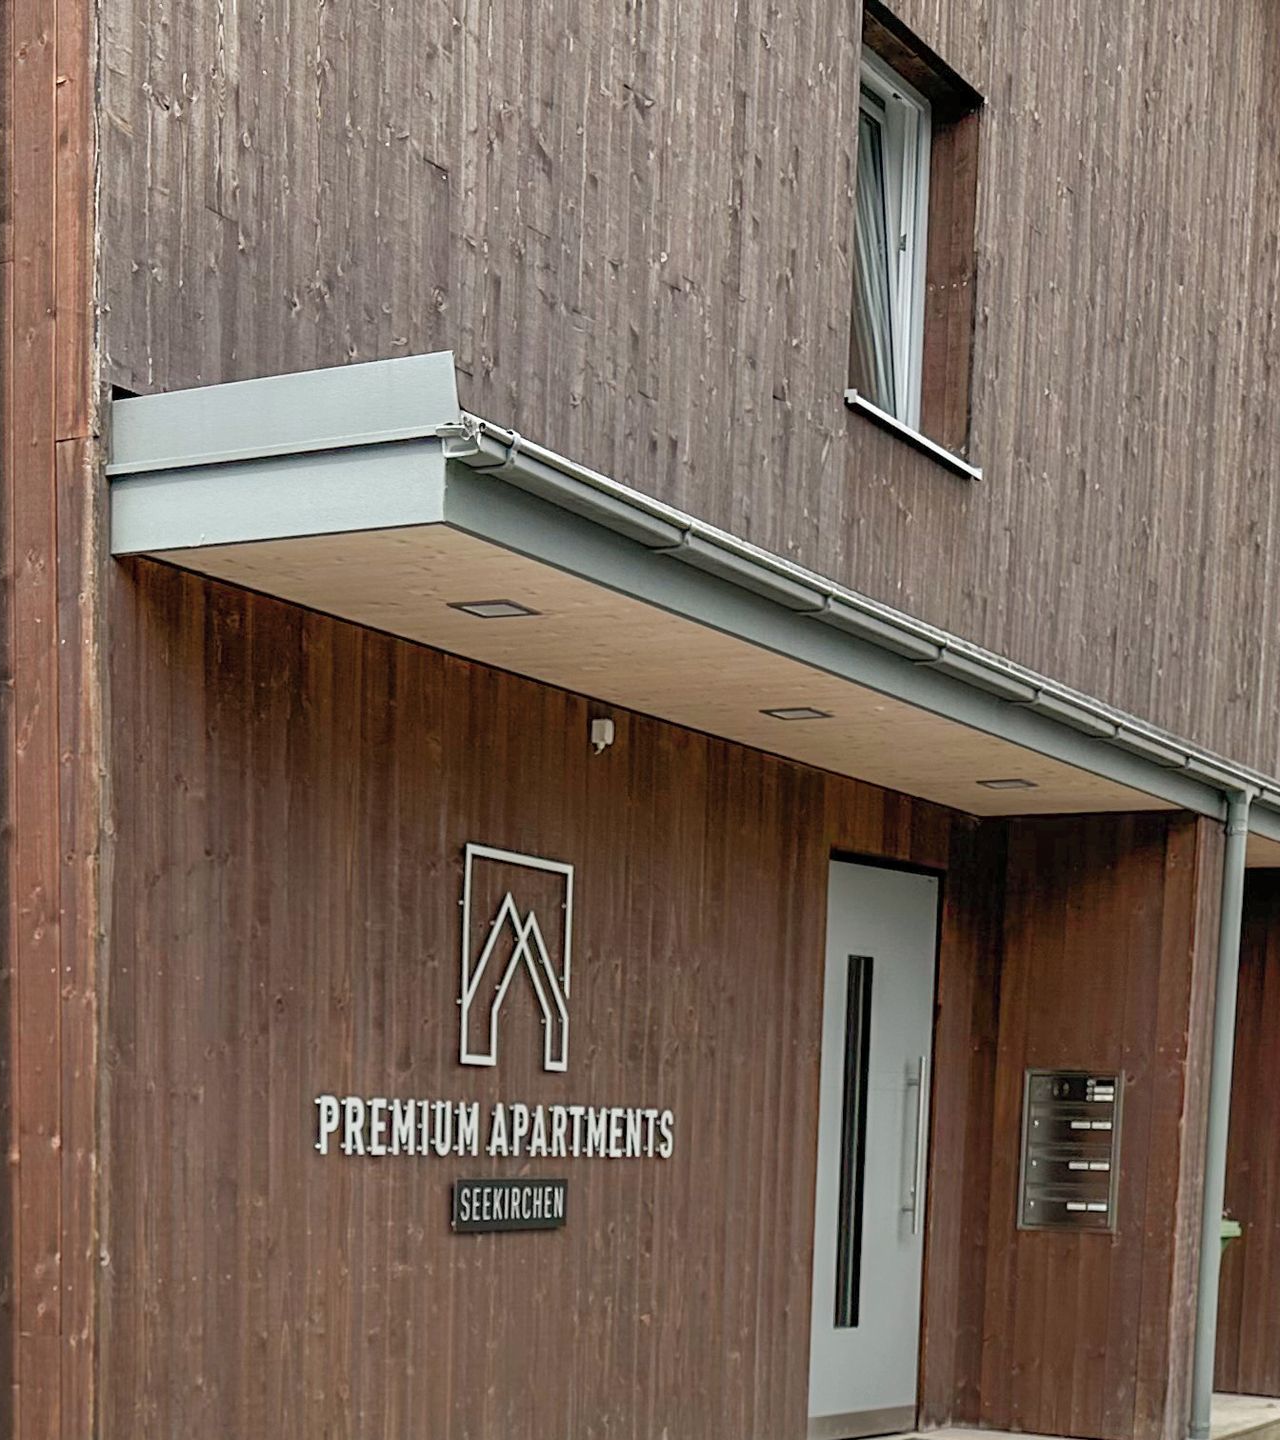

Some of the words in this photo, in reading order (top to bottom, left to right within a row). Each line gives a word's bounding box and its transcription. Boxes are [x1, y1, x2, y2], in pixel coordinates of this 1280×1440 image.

[319, 1095, 480, 1156] PREMIUM
[489, 1103, 675, 1159] APARTMENTS
[460, 1186, 565, 1222] SEEKIRCHEN
